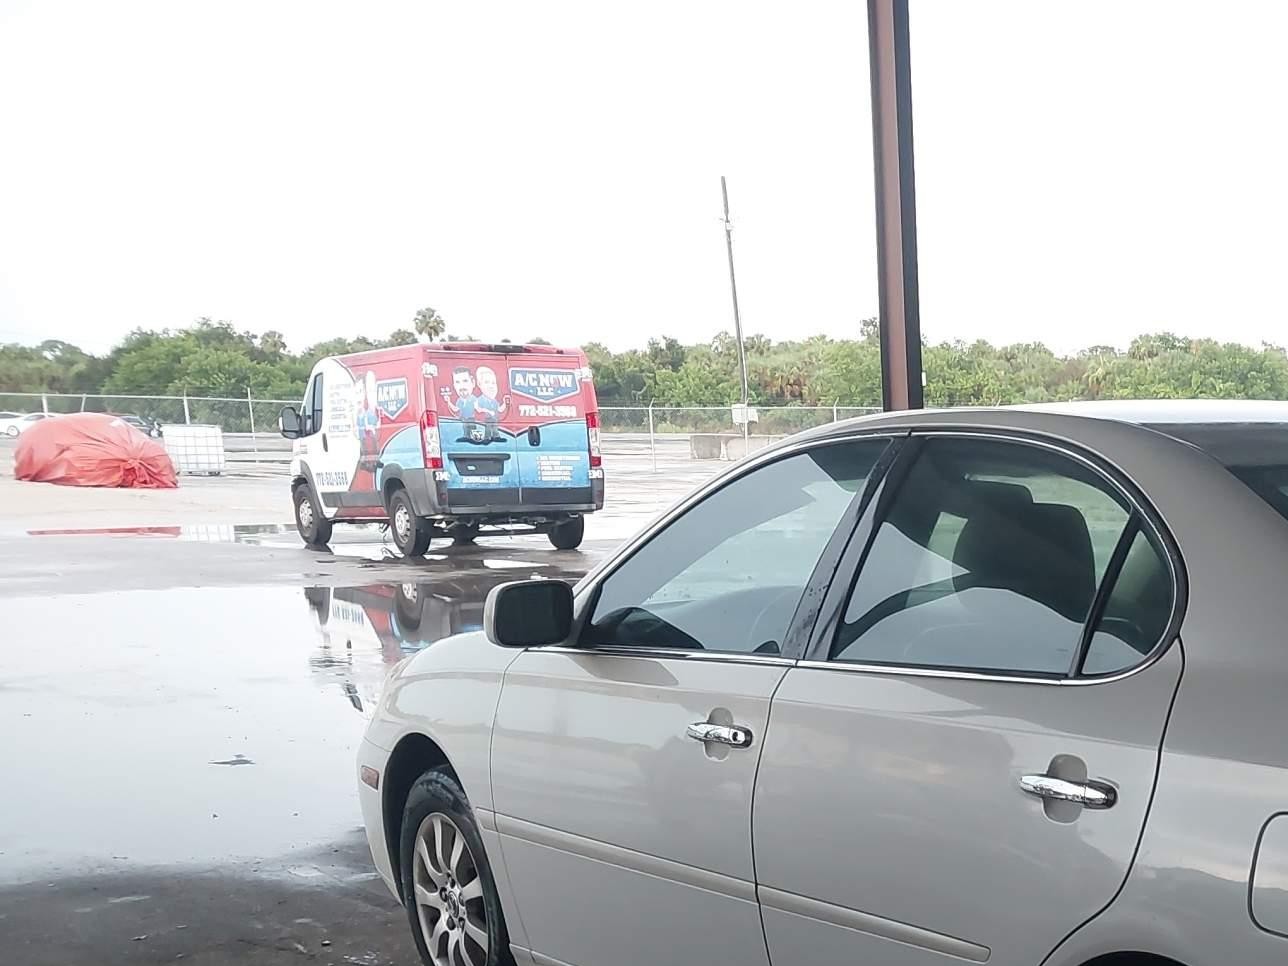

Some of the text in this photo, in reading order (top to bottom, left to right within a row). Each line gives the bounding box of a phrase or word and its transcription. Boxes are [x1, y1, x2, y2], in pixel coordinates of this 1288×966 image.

[515, 373, 573, 387] A/C NOW
[536, 387, 554, 395] LLC
